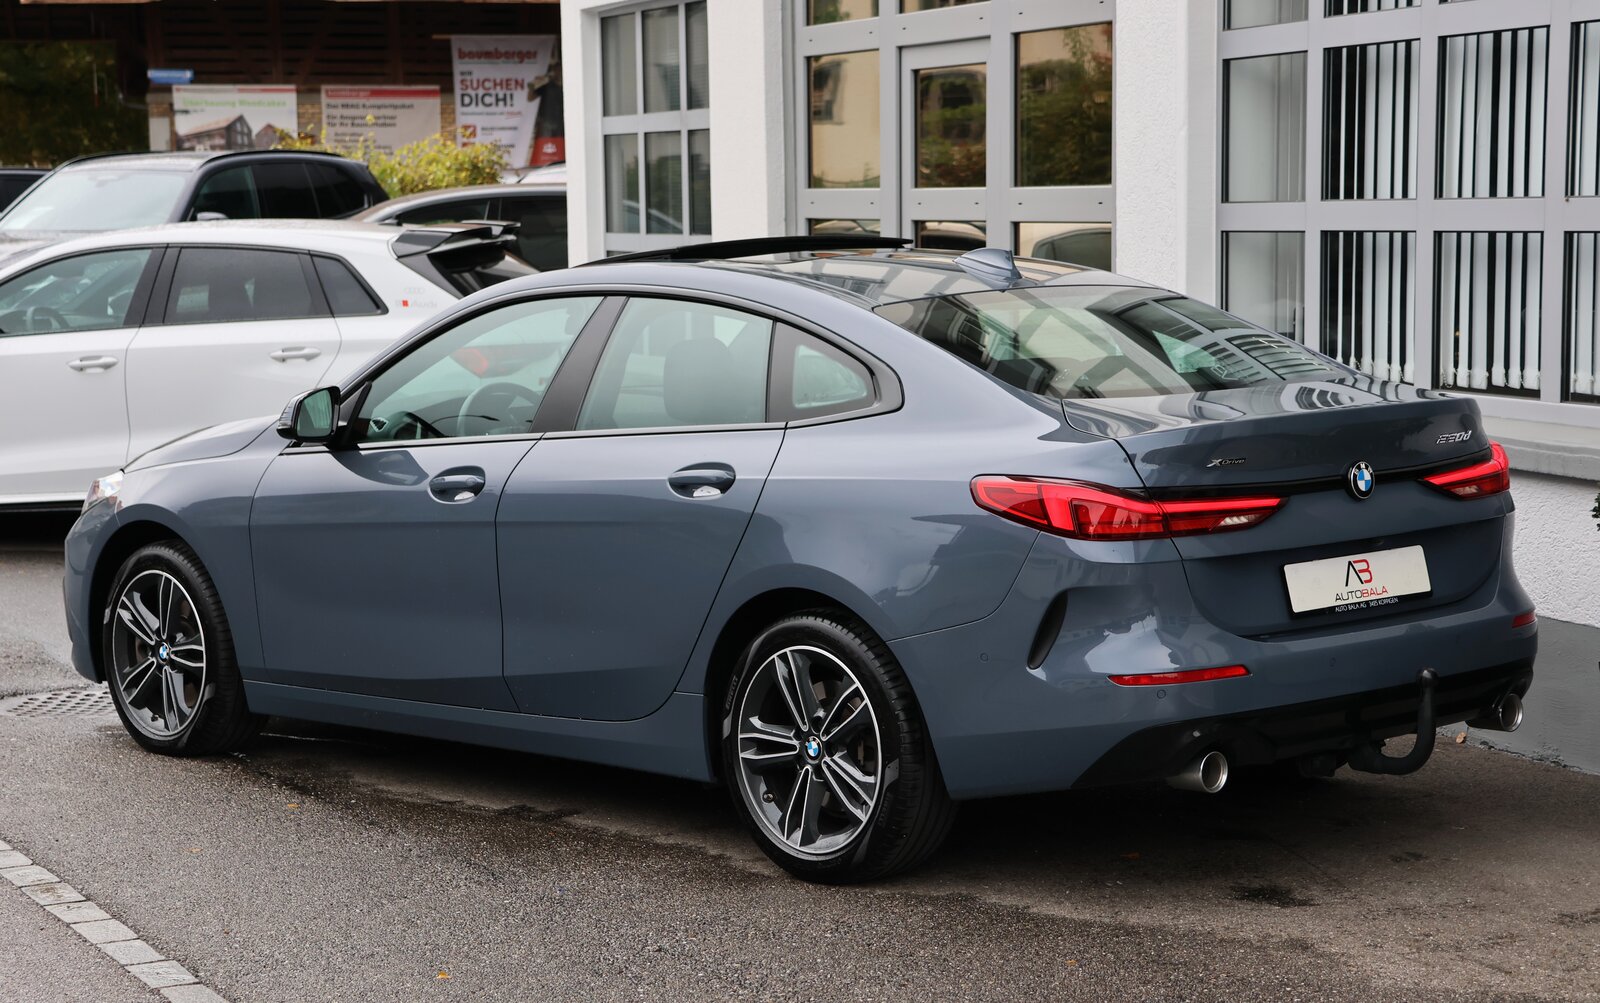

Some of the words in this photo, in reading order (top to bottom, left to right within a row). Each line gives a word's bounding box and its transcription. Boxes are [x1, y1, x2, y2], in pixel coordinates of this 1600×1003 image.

[458, 47, 538, 64] baumberger
[460, 78, 525, 91] SUCHEN
[461, 93, 515, 107] DICH!
[1335, 586, 1388, 602] AUTOBALA
